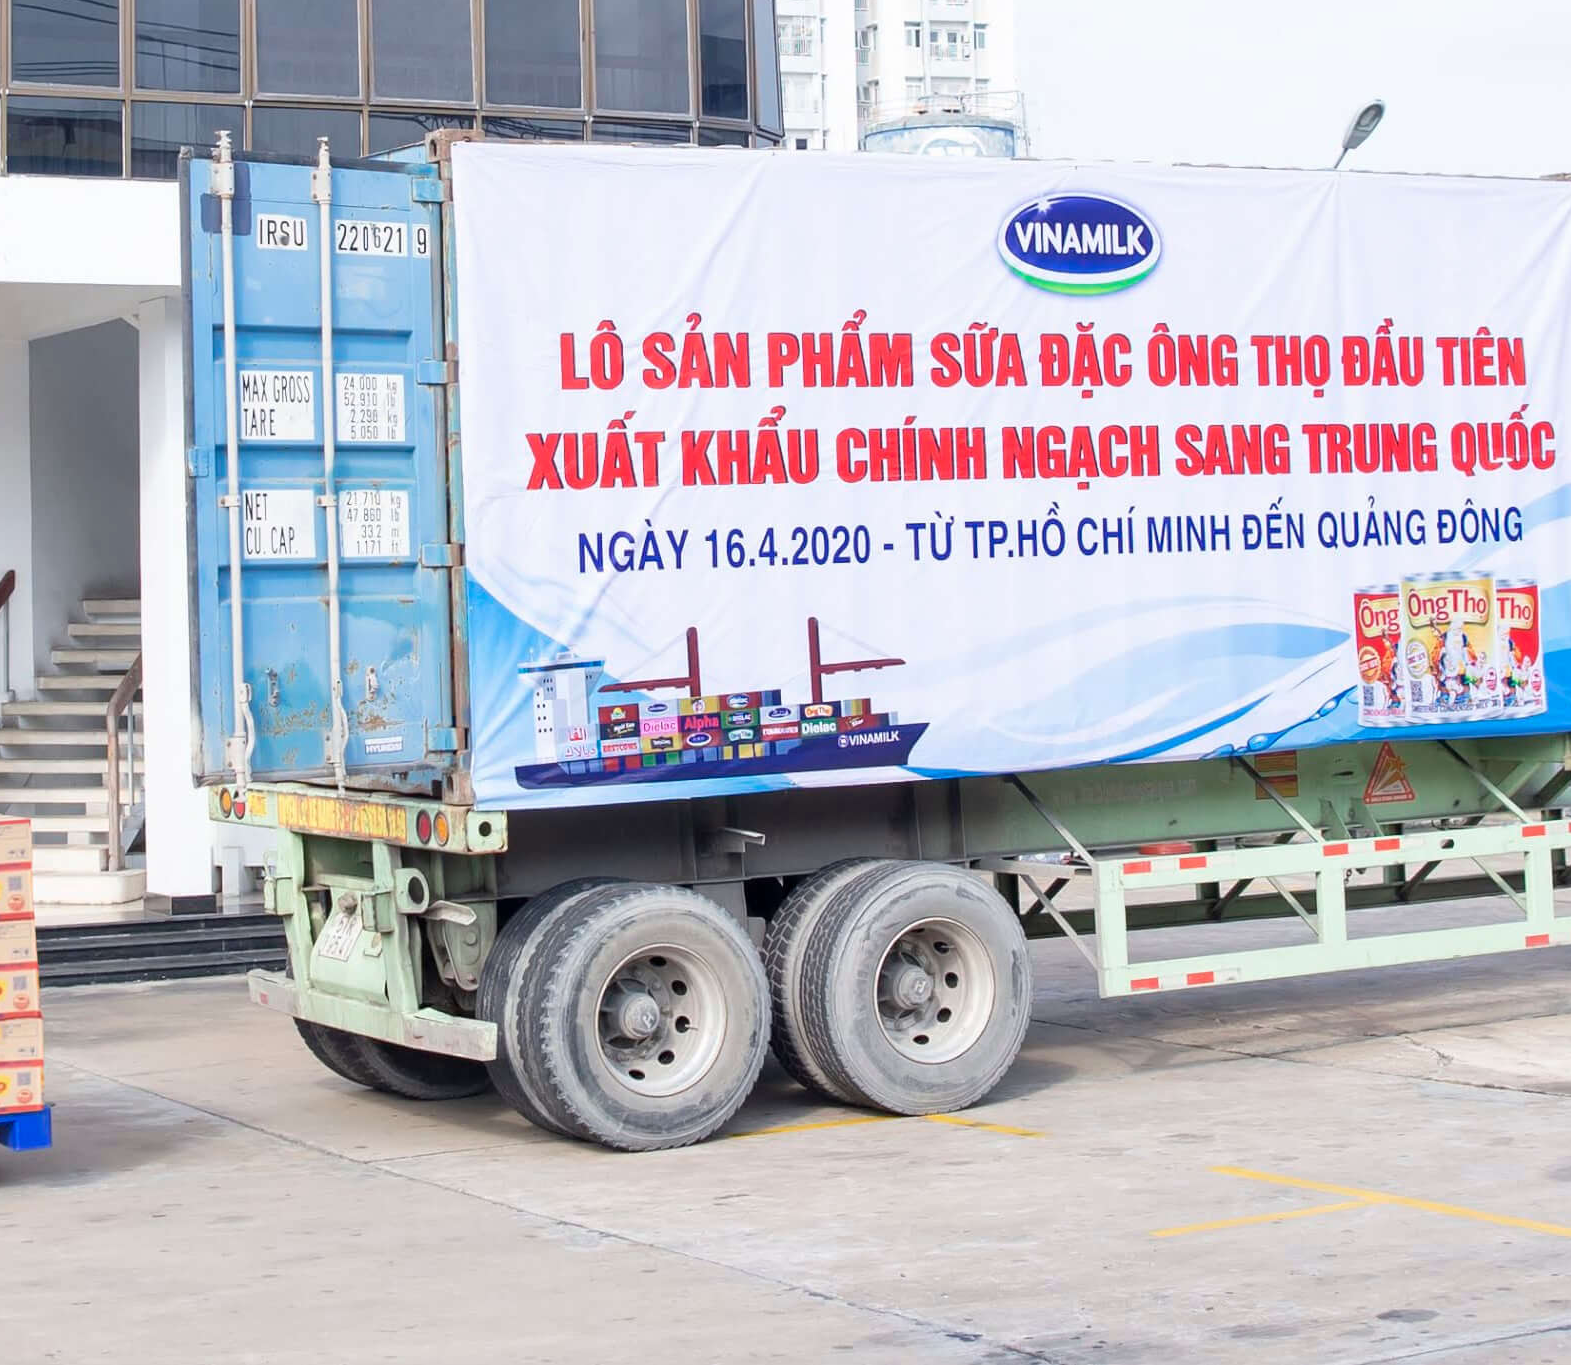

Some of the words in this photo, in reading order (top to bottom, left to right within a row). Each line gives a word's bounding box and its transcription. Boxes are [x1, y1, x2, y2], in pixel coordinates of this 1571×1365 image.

[417, 228, 427, 254] 9
[1013, 219, 1148, 258] VINAMILK
[560, 321, 623, 391] LÔ
[642, 313, 751, 389] SẢN
[767, 310, 914, 389] PHẨM
[930, 323, 1028, 388] SỮA
[1039, 323, 1132, 400] ĐẶC
[1147, 323, 1239, 387] ÔNG
[1250, 336, 1331, 399] THỌ
[1342, 318, 1425, 387] ĐẦU
[1436, 326, 1527, 387] TIÊN
[242, 374, 268, 403] MAX
[273, 375, 311, 403] GROSS
[243, 408, 277, 436] TARE
[525, 411, 665, 491] XUẤT
[680, 405, 820, 486] KHẨU
[836, 415, 987, 483] CHÍNH
[1002, 425, 1161, 491] NGẠCH
[1174, 423, 1291, 477] SANG
[1302, 422, 1438, 474] TRUNG
[1450, 405, 1556, 477] QUỐC
[245, 493, 268, 521] NET
[578, 518, 689, 574] NGÀY
[704, 524, 871, 569] 16.4.2020
[905, 510, 955, 562] TỪ
[964, 501, 1066, 560] TP.HỒ
[1076, 505, 1134, 557] CHÍ
[1146, 514, 1231, 554] MINH
[1241, 496, 1305, 551] ĐẾN
[1317, 495, 1427, 551] QUẢNG
[1436, 497, 1524, 545] ĐÔNG
[643, 720, 676, 733] Dielac
[684, 715, 719, 730] Alpha
[801, 722, 837, 735] Dielac
[849, 730, 900, 747] VINAMILK
